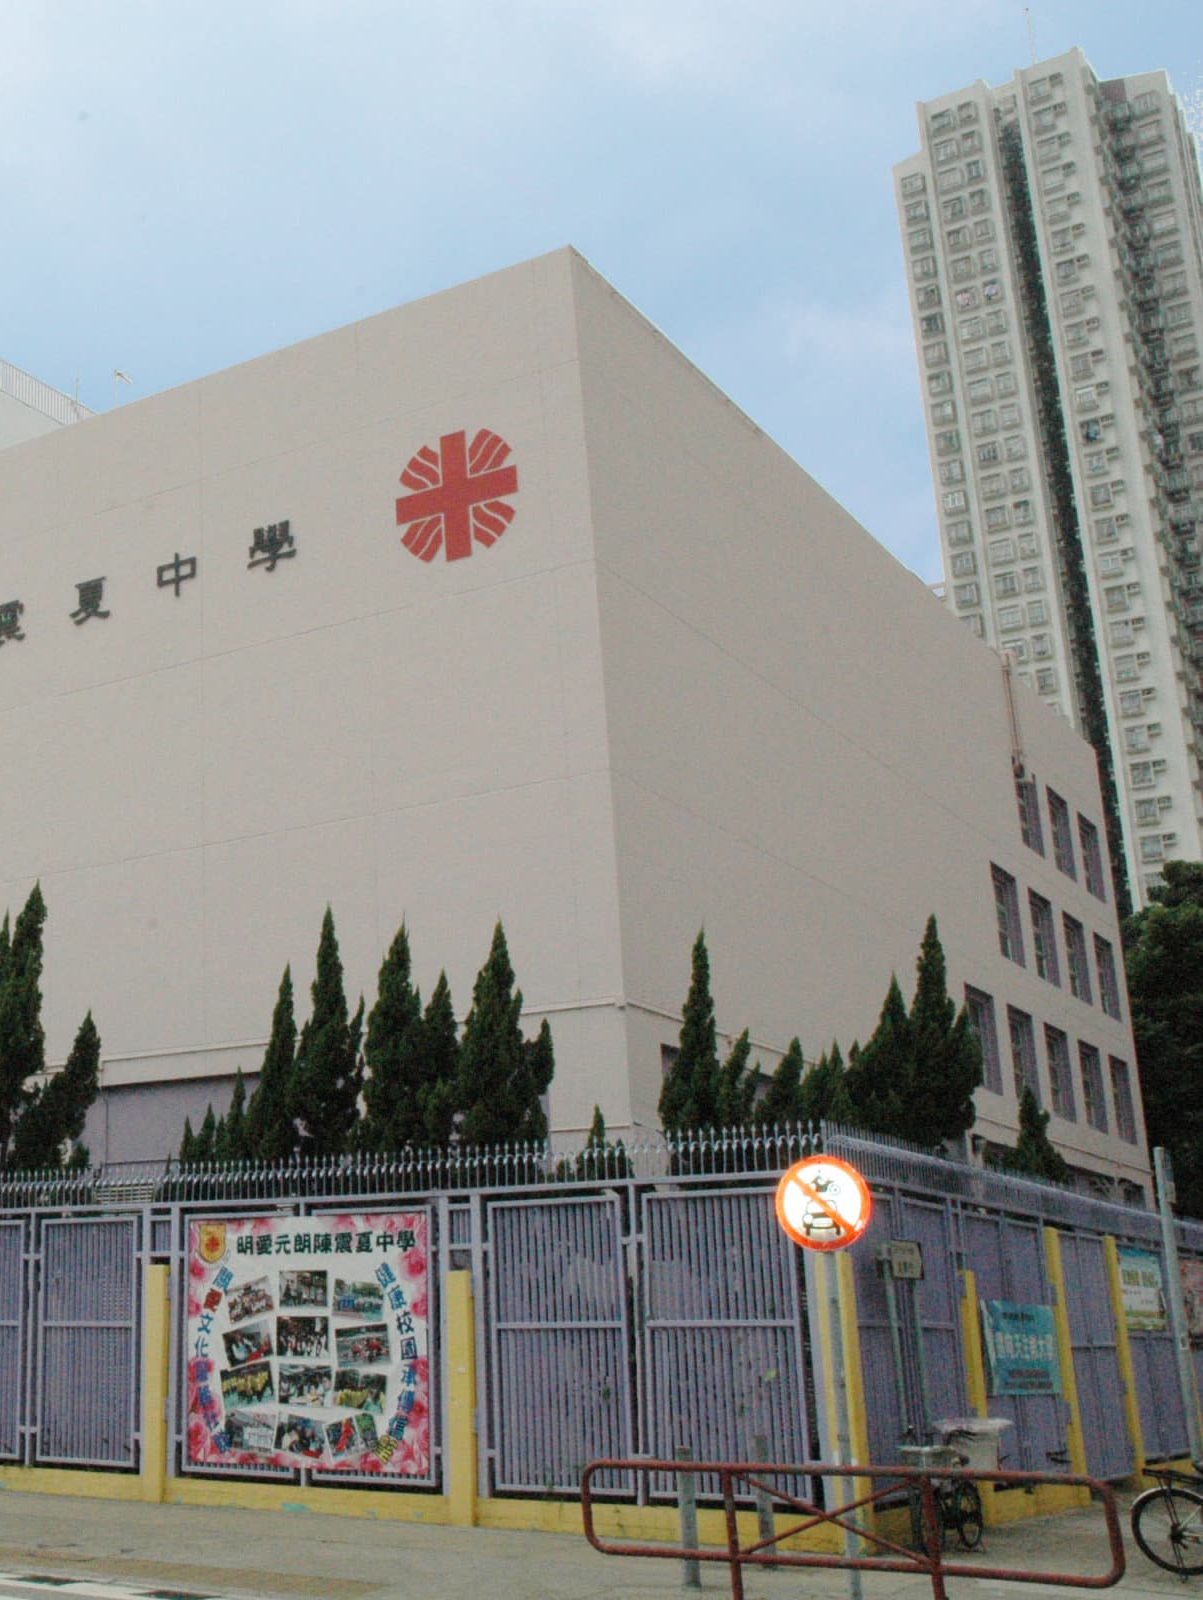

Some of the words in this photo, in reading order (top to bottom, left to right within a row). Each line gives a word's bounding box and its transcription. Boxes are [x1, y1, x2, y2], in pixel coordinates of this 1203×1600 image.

[236, 1230, 416, 1256] 明愛元朗陳震夏中學
